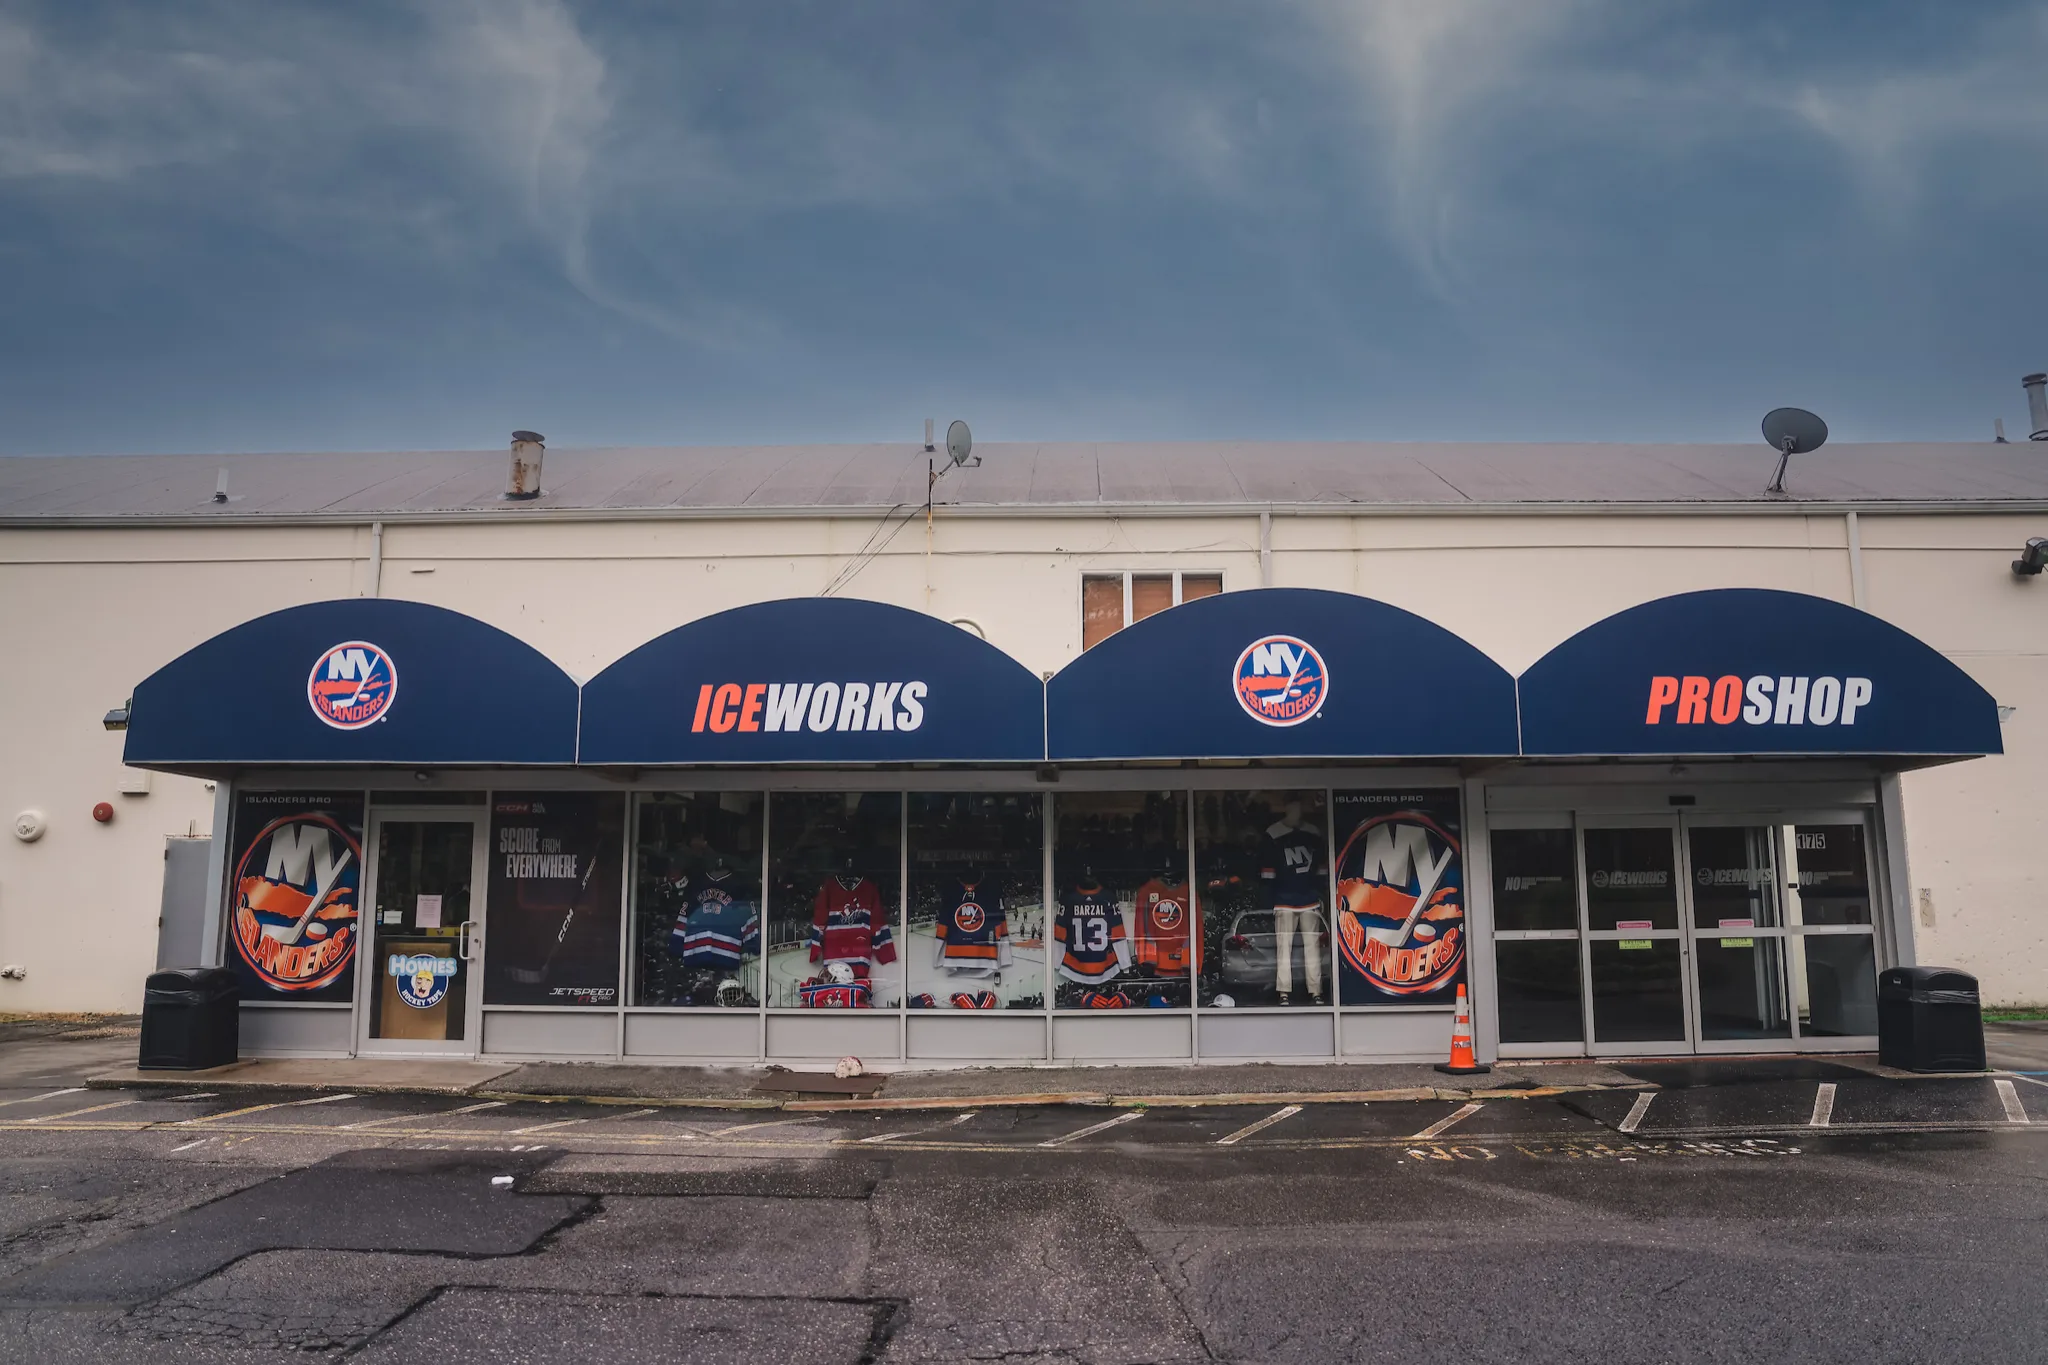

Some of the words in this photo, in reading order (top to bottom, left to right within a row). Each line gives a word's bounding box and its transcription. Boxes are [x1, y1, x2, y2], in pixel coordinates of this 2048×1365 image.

[328, 648, 381, 694] NY
[1252, 643, 1307, 688] NY
[317, 691, 384, 721] ISLANDERS
[691, 681, 928, 733] ICEWORKS
[1245, 686, 1317, 718] ISLANDERS
[1645, 674, 1873, 726] PROSHOP
[245, 796, 306, 804] ISLANDERS
[309, 796, 332, 804] PRO
[1335, 795, 1398, 803] ISLANDERS
[500, 828, 540, 853] SCORE
[542, 838, 561, 853] FROM
[265, 823, 352, 915] NY
[506, 854, 578, 878] EVERYWHERE
[1363, 823, 1454, 918] NY
[1610, 871, 1668, 885] ICEWORKS
[1504, 876, 1521, 891] NO
[558, 908, 574, 943] CCM
[1073, 904, 1106, 916] BARZAL
[237, 908, 349, 978] ISLANDERS
[1072, 918, 1109, 952] 13
[1338, 912, 1459, 982] ISLANDERS
[390, 956, 456, 975] HOWIES
[401, 989, 427, 1006] HOCKEY
[427, 989, 443, 1004] TAPE
[549, 988, 615, 996] JETSPEED
